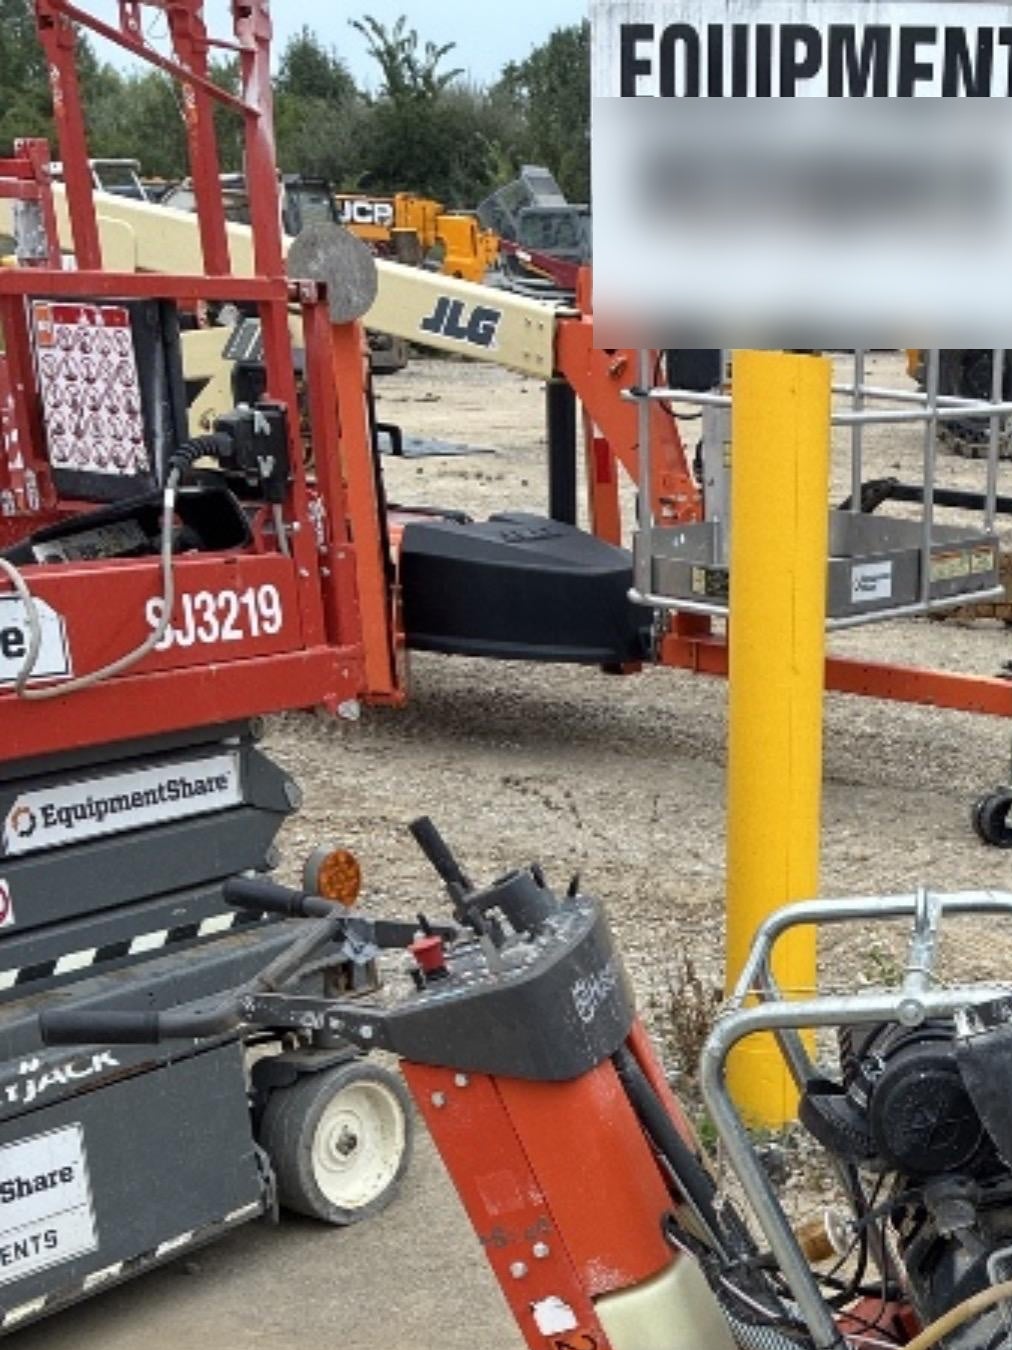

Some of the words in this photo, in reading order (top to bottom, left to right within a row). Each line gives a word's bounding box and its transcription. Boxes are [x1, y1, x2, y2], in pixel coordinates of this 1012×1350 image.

[421, 296, 501, 346] JLG
[145, 584, 282, 650] SJ3219
[39, 773, 229, 829] EquipmentShare
